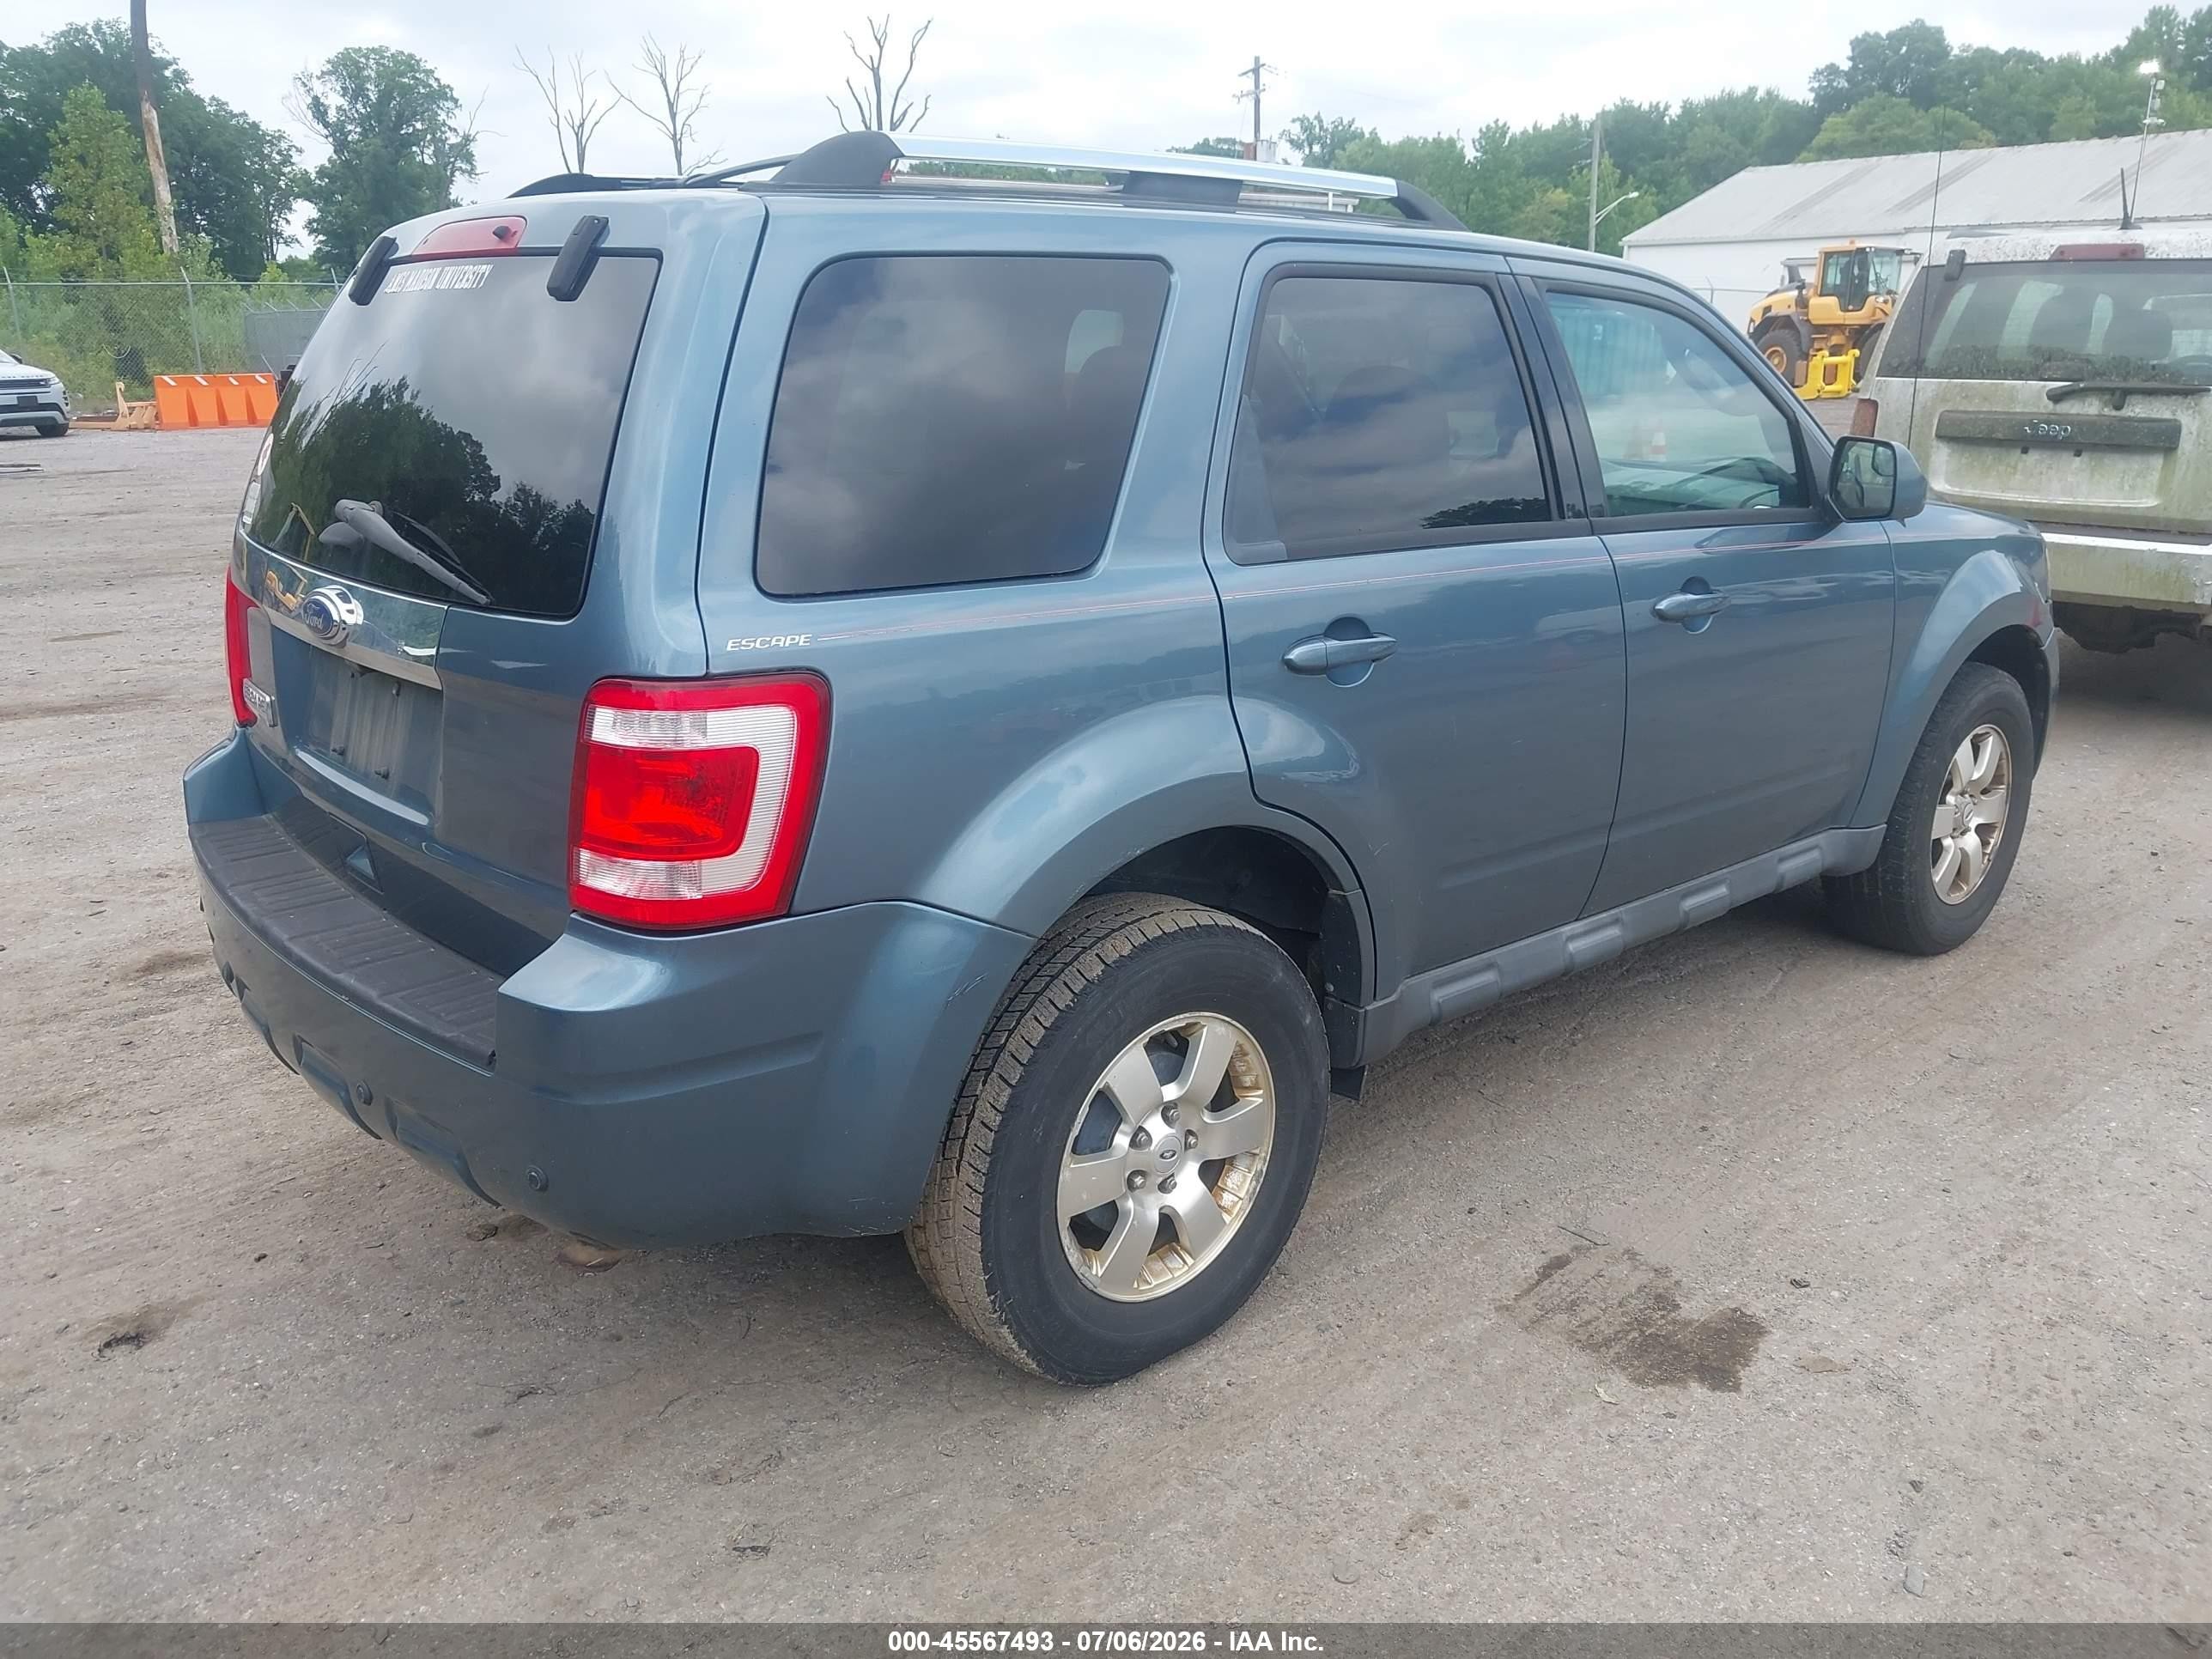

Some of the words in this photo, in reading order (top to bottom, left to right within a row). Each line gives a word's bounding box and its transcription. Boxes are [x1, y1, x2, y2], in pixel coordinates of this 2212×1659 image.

[435, 264, 495, 289] UNIVERSITY
[303, 603, 325, 630] Ford
[726, 634, 812, 651] ESCAPE
